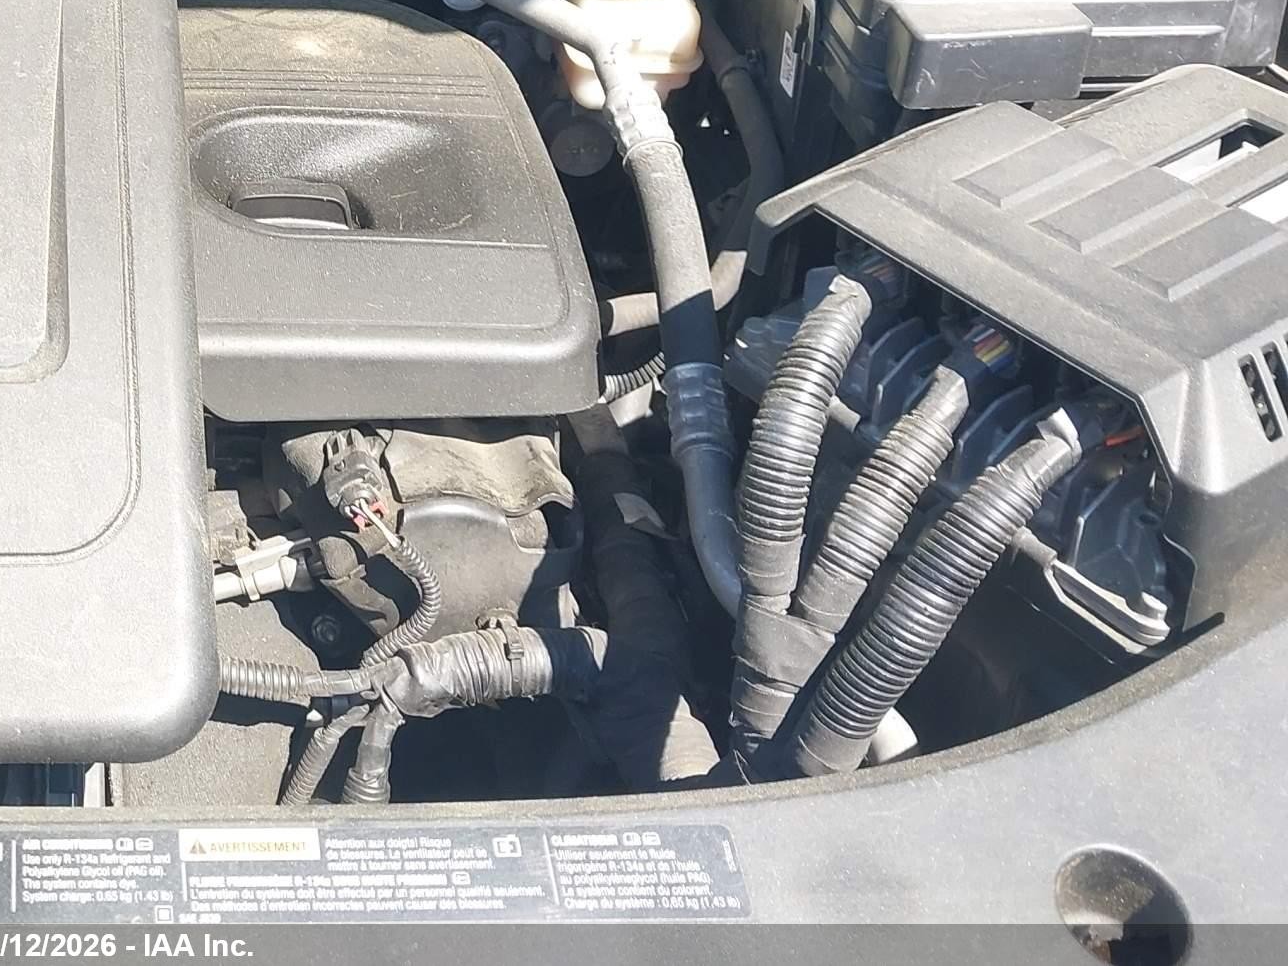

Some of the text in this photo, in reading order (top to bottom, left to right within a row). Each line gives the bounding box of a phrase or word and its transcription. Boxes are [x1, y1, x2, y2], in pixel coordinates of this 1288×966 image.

[209, 841, 307, 852] AVERTISSEMENT
[325, 838, 366, 849] Attention
[368, 839, 385, 849] aux
[419, 837, 451, 850] Risque
[22, 854, 171, 866] Use only R-134a Refrigerant and
[325, 850, 339, 860] de
[403, 849, 451, 859] ventilateur
[453, 848, 474, 859] peut
[554, 848, 676, 860] Utiliser seulement le fluide
[368, 861, 402, 870] tourner
[404, 861, 426, 870] sans
[609, 861, 644, 872] R-134a
[646, 861, 656, 871] et
[658, 861, 670, 871] de
[81, 866, 110, 878] Glycol
[111, 866, 123, 876] oil
[125, 866, 148, 877] (PAG
[23, 879, 139, 891] The system contains dye.
[560, 874, 572, 885] au
[241, 889, 254, 899] du
[296, 889, 315, 899] doit
[377, 889, 393, 900] par
[395, 888, 408, 898] un
[409, 887, 455, 899] personnel
[562, 886, 574, 896] Le
[618, 885, 657, 896] contient
[658, 885, 670, 896] du
[22, 891, 173, 903] System charge: 0.65 kg (1.43 lb)
[190, 901, 210, 912] Des
[405, 900, 437, 910] causer
[564, 898, 598, 910] Charge
[600, 898, 613, 908] du
[686, 897, 699, 910] kg
[727, 897, 741, 909] lb)
